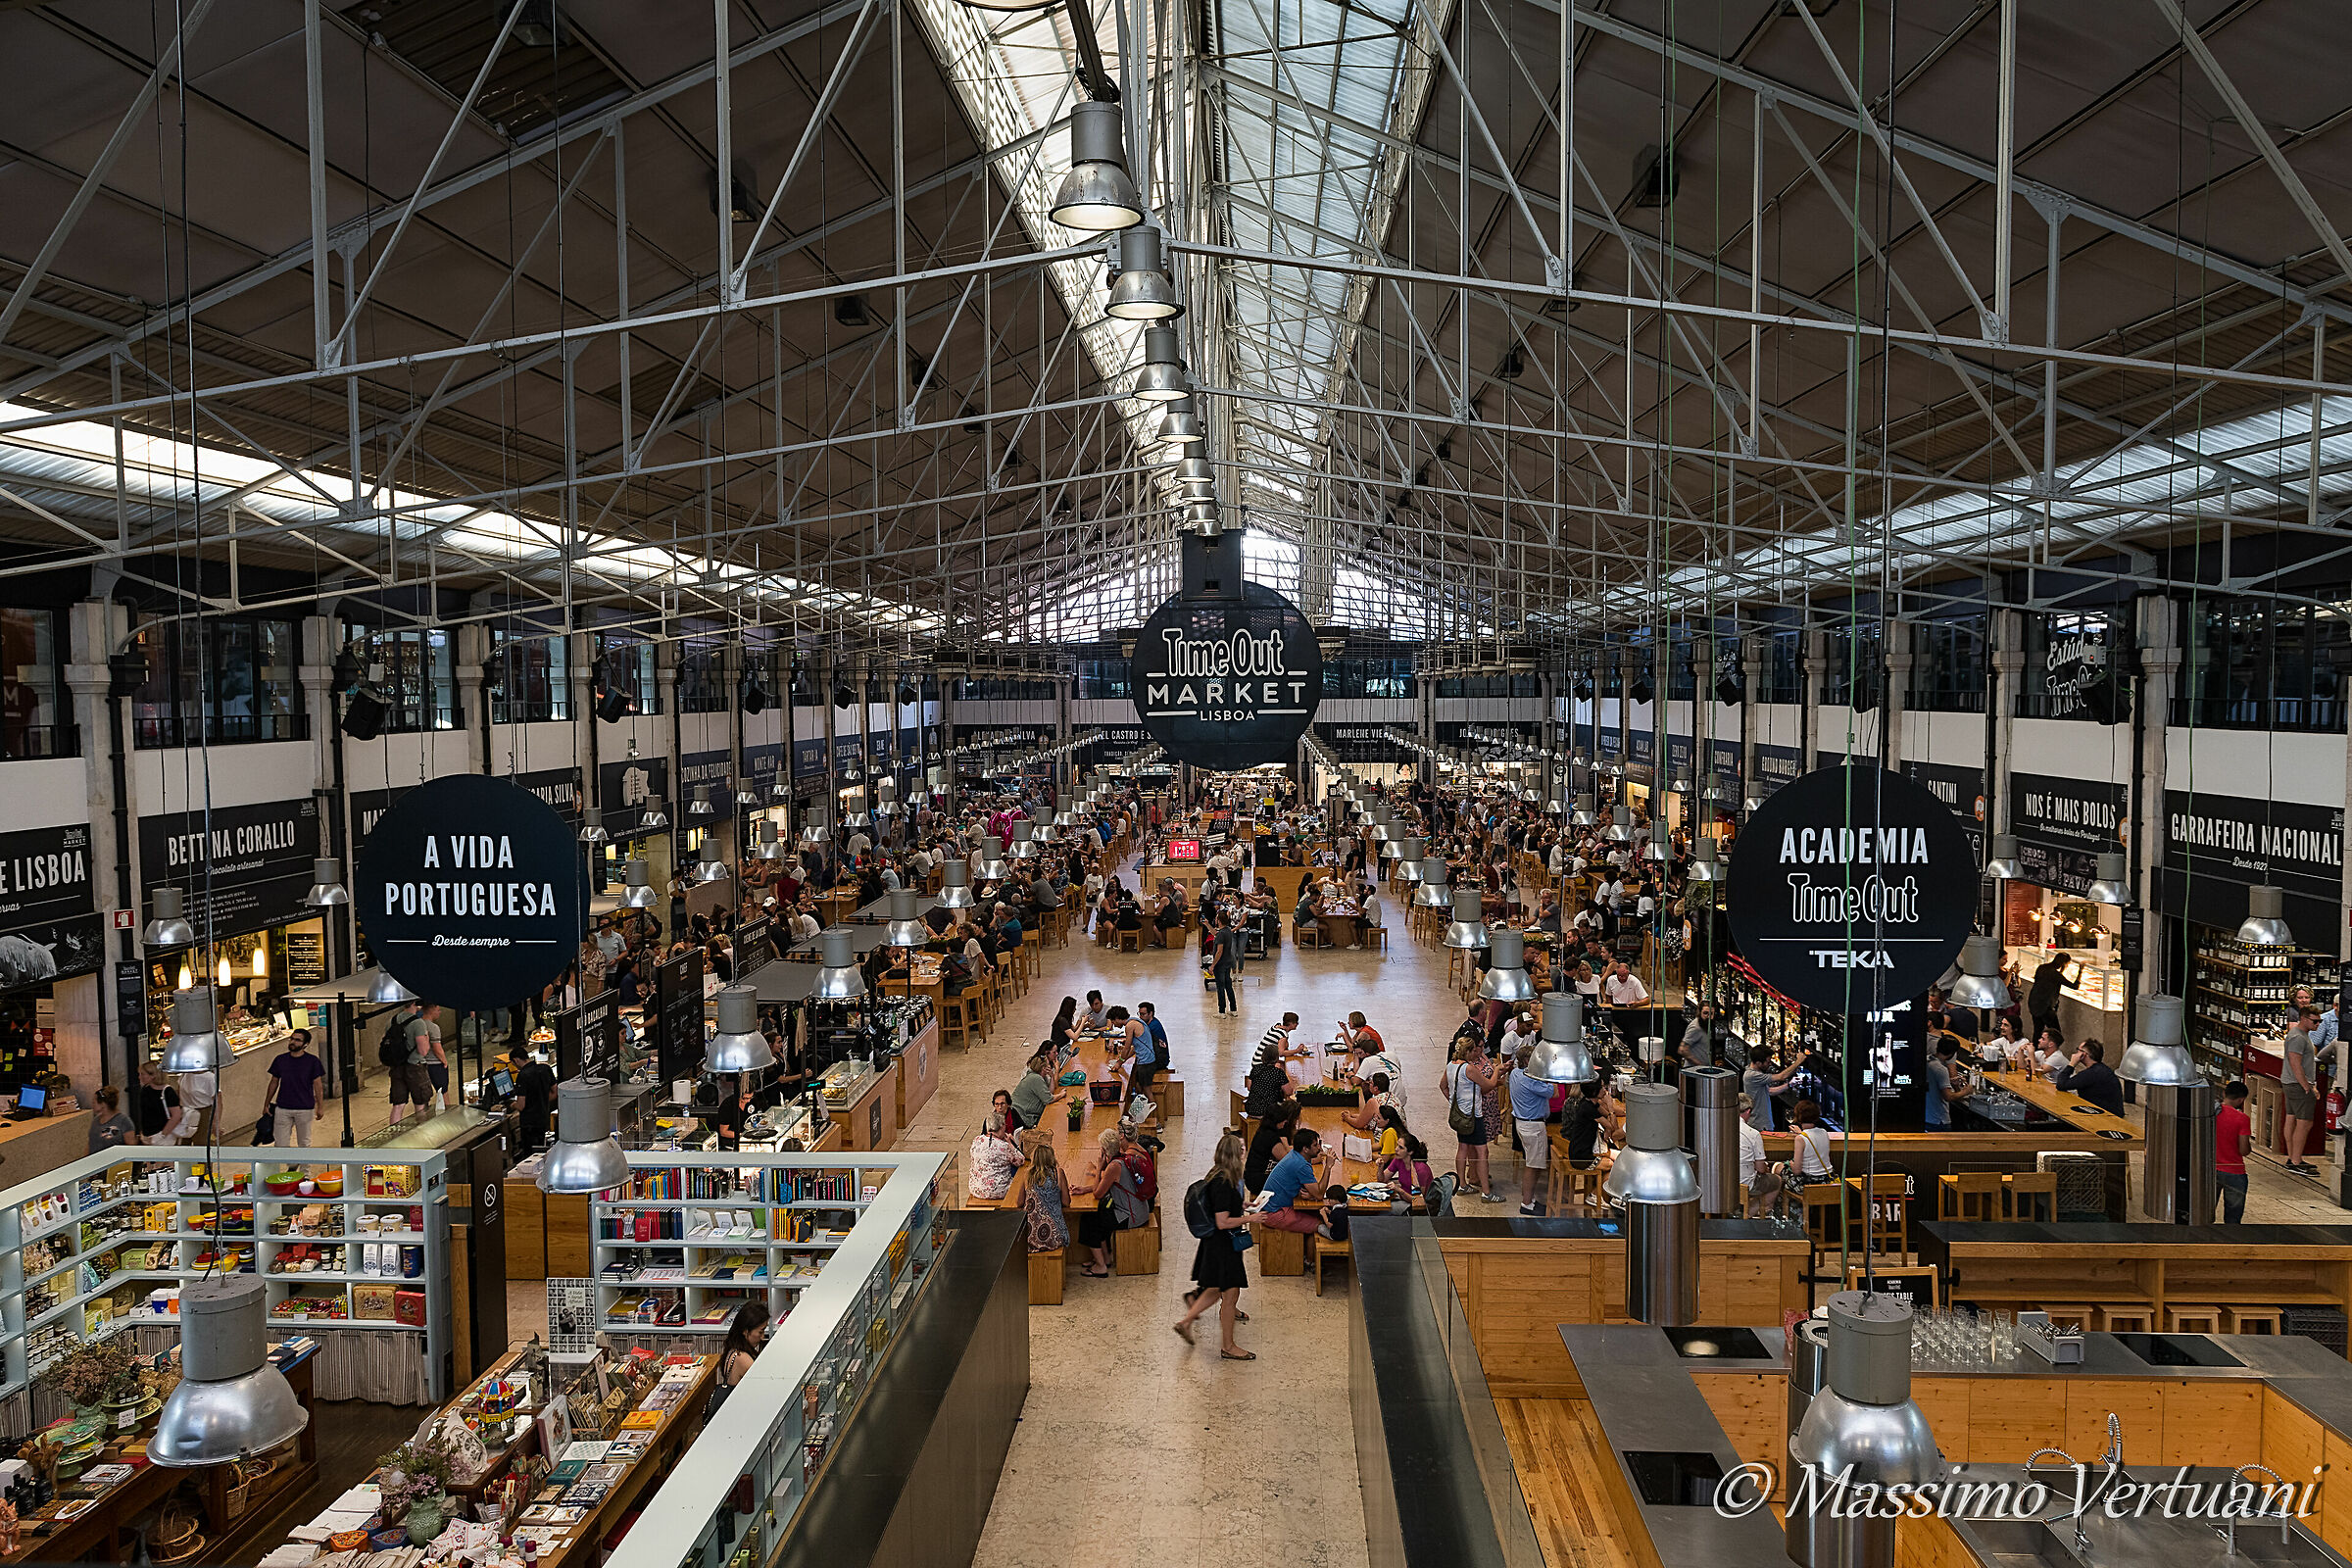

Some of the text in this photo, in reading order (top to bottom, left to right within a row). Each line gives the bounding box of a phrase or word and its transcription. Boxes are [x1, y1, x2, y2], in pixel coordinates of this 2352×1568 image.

[1162, 628, 1284, 676] Time Out
[2047, 632, 2083, 671] Estúd
[1147, 682, 1306, 706] MARKET
[1200, 710, 1255, 721] LISBOA
[1111, 730, 1139, 740] CASTRO
[1336, 728, 1369, 739] MARLENE
[554, 782, 574, 804] SILVA
[2055, 797, 2080, 823] MAIS
[2082, 801, 2116, 830] BOLOS
[168, 819, 295, 866] BETTNA CORALLO
[424, 835, 514, 868] A VIDA
[1779, 827, 1929, 863] ACADEMIA
[2172, 812, 2341, 866] GARRAFEIRA NACIONAL
[14, 850, 86, 892] LISBOA
[2231, 856, 2253, 869] Desde
[385, 883, 557, 916] PORTUGUESA
[1788, 872, 1919, 923] Time Out
[431, 934, 511, 949] Desde sempre
[1809, 950, 1894, 968] TEKA
